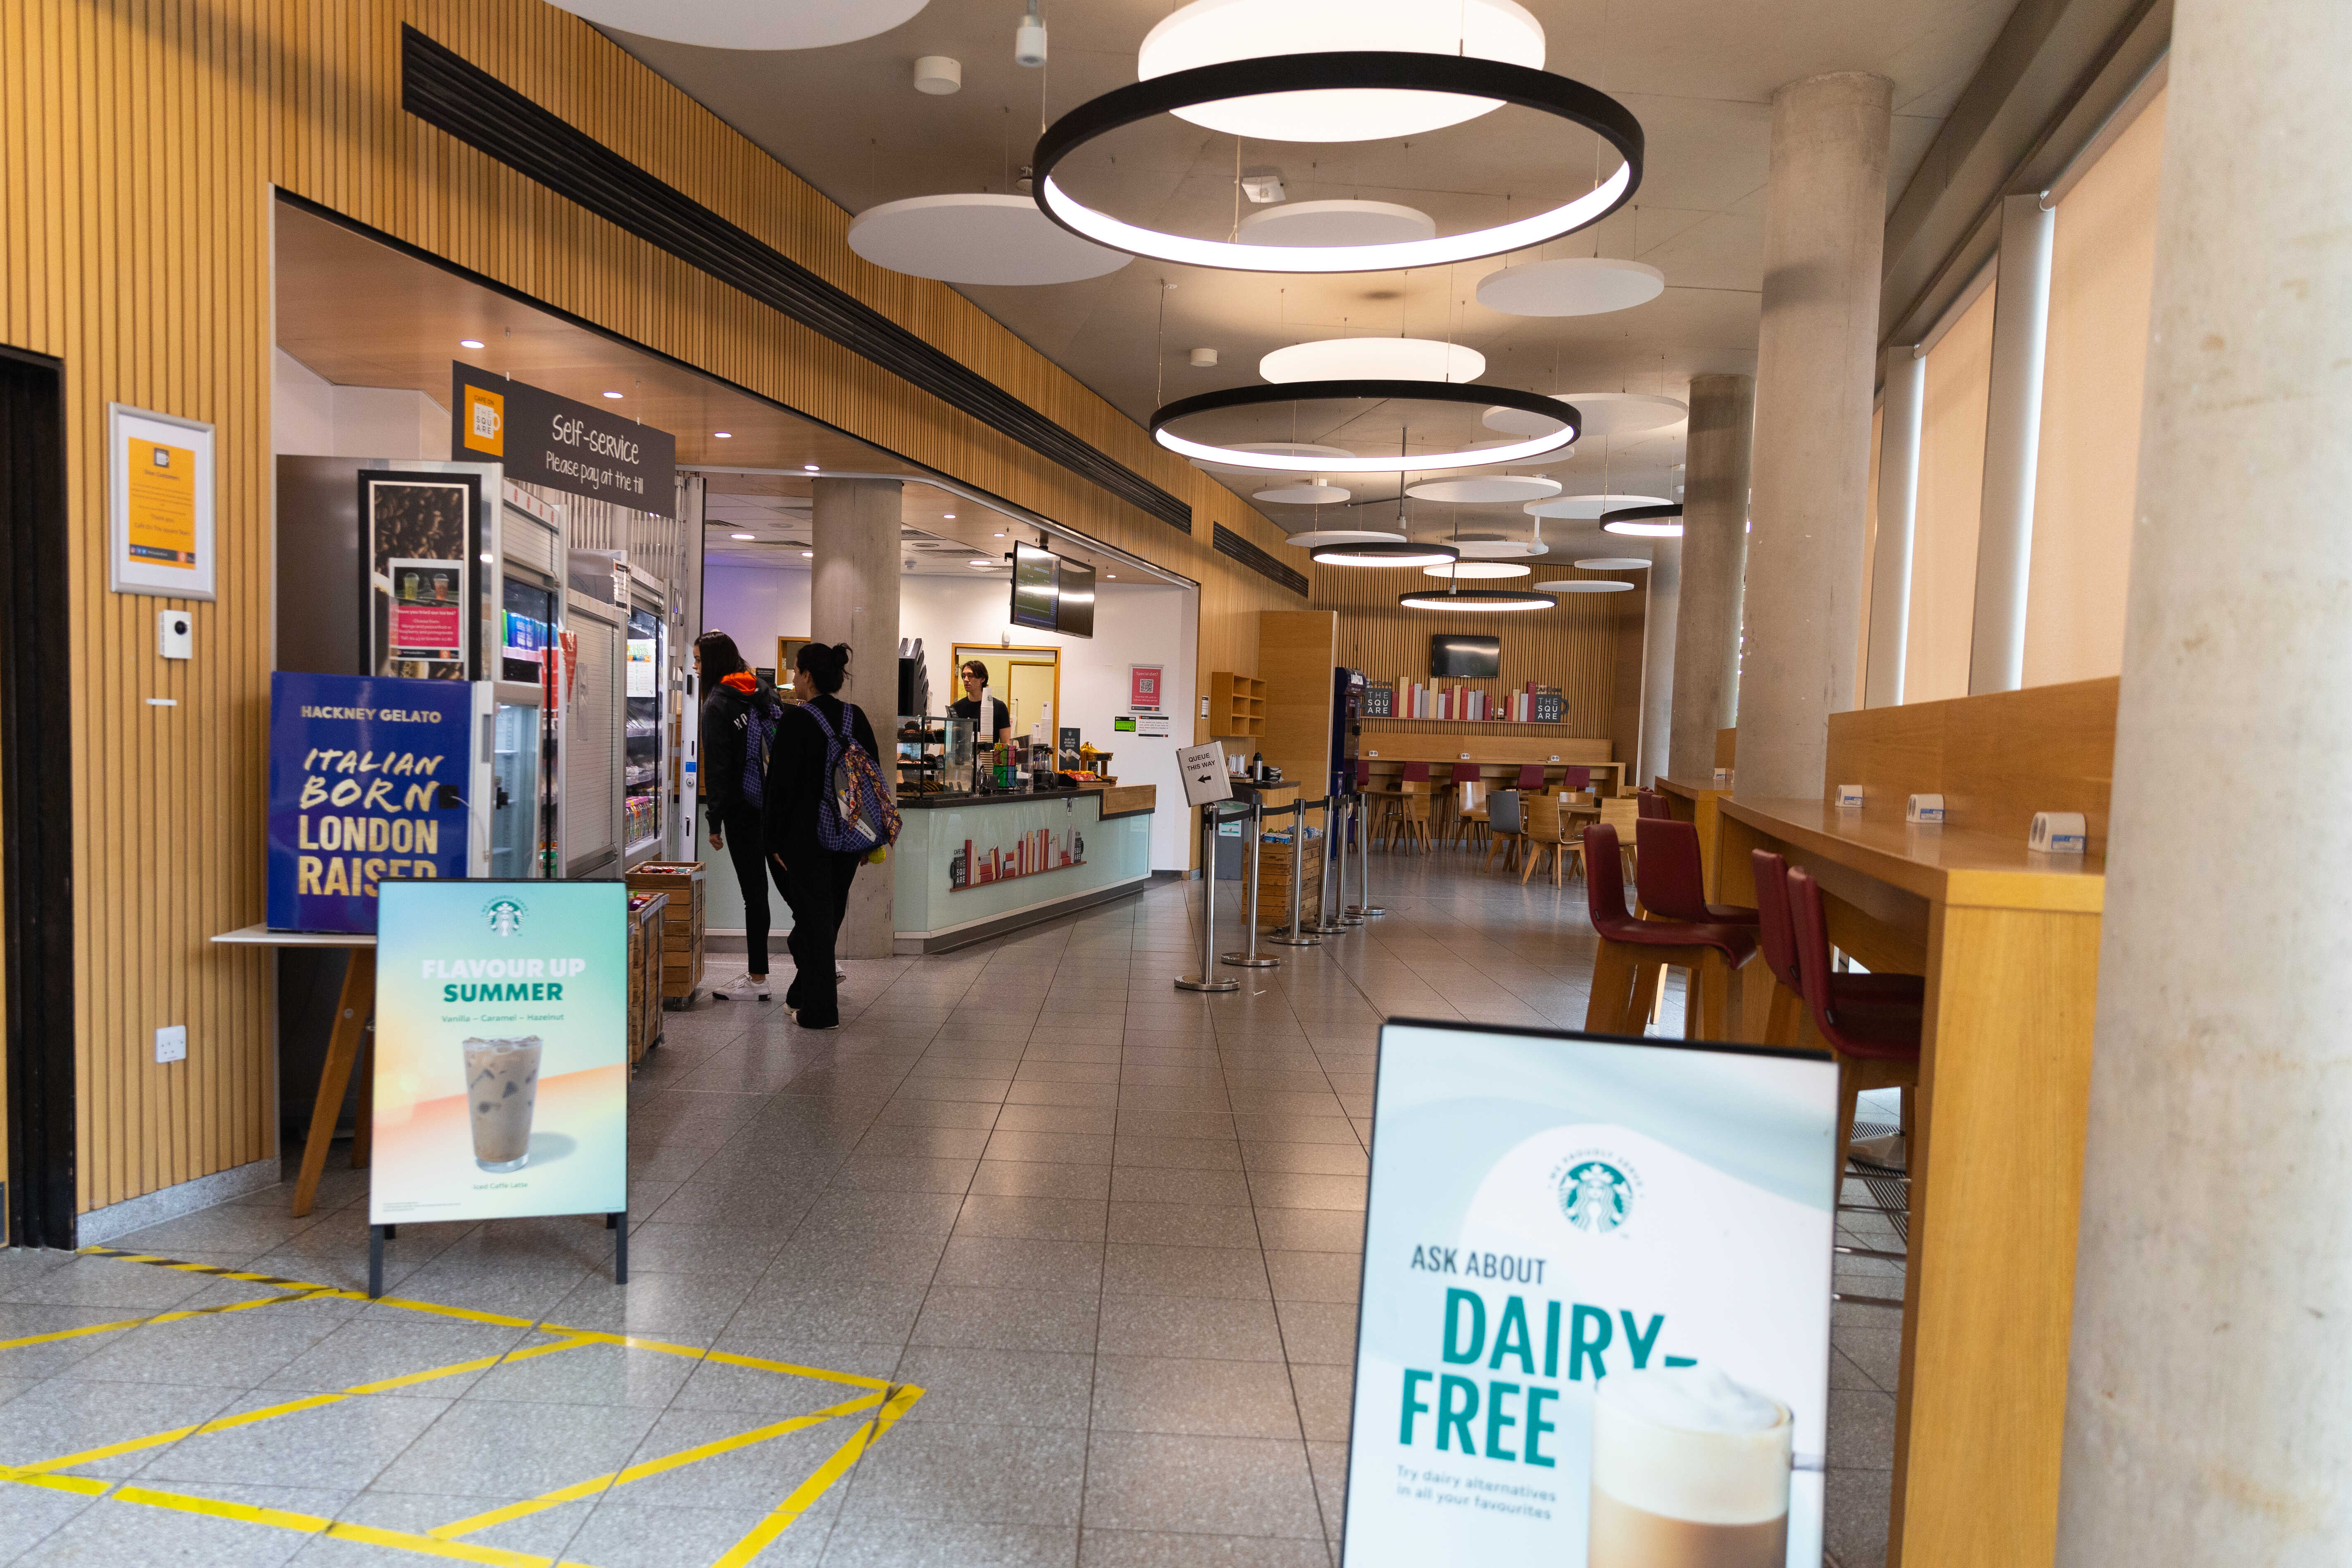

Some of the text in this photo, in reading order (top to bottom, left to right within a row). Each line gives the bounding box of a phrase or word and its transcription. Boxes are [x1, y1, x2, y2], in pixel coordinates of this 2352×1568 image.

[476, 407, 491, 418] THE
[476, 416, 492, 426] SQU
[476, 426, 491, 435] ARE
[553, 414, 639, 464] Self-service
[546, 451, 644, 495] Please pay at the till
[301, 705, 442, 723] HACKNEY GELATO
[304, 748, 445, 776] ITALIAN
[1189, 753, 1210, 762] QUEUE
[299, 775, 440, 813] BORN
[299, 814, 438, 855] LONDON
[957, 868, 965, 876] SQU
[422, 958, 586, 979] FLAVOUR UP
[443, 983, 563, 1002] SUMMER
[1411, 1243, 1547, 1286] ASK ABOUT
[1442, 1287, 1698, 1381] DAIRY-
[1399, 1367, 1560, 1468] FREE
[1397, 1465, 1556, 1503] Try dairy alternatives
[1397, 1485, 1551, 1520] in all your favourites
